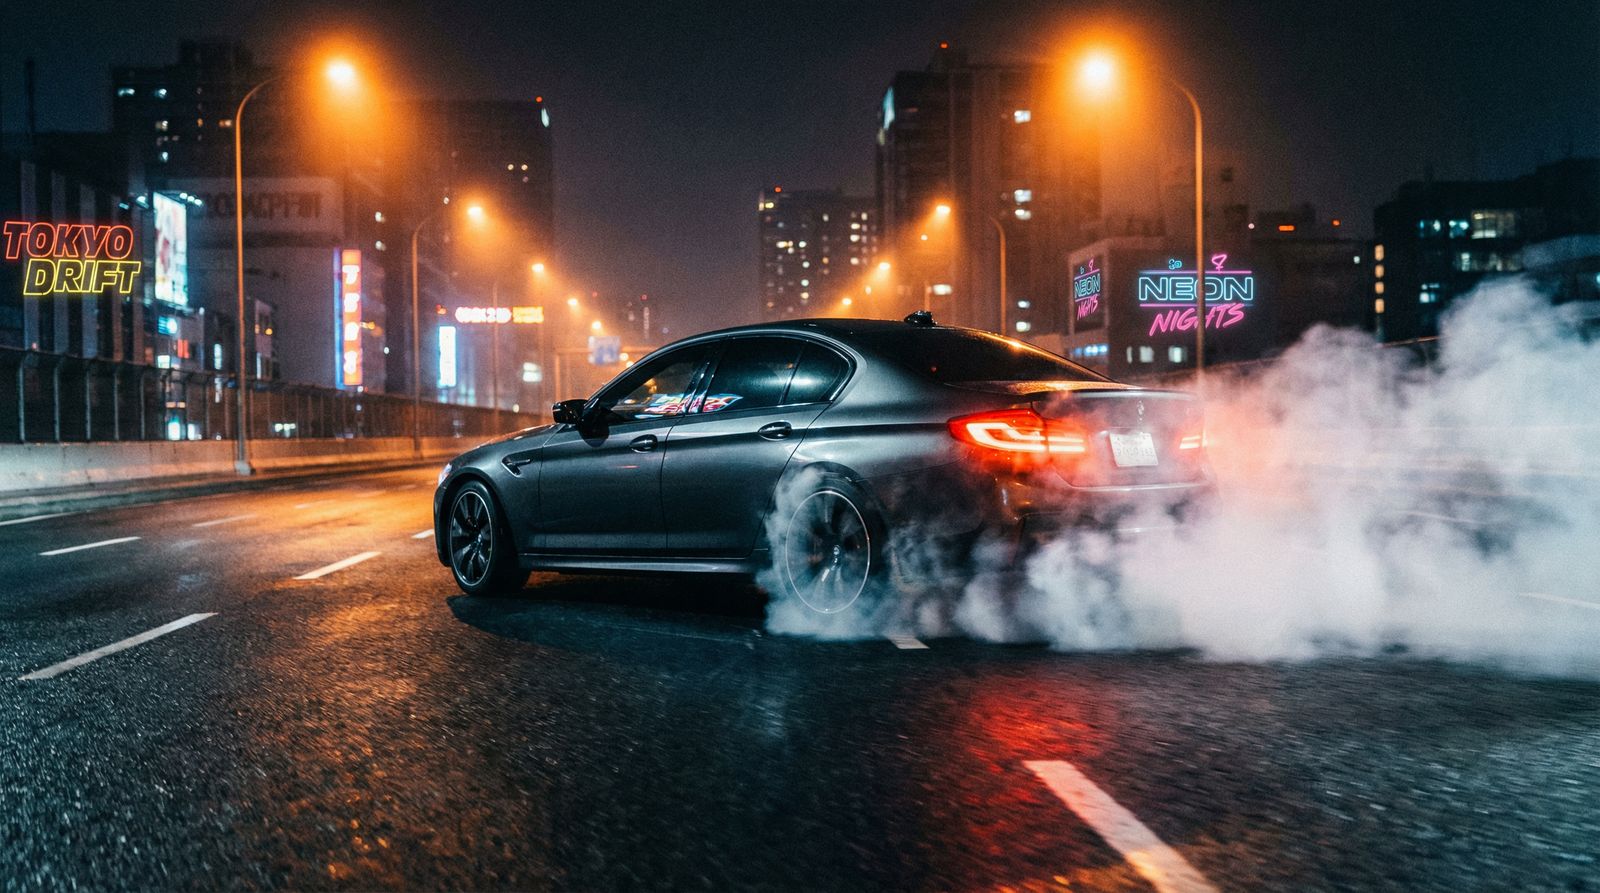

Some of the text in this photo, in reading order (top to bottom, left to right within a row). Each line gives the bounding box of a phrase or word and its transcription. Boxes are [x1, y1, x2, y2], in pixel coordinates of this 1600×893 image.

[3, 222, 134, 260] TOKYO
[23, 259, 142, 296] DRIFT
[1074, 273, 1101, 299] NEON
[1138, 277, 1254, 301] NEON
[1077, 294, 1099, 321] NIGHTS
